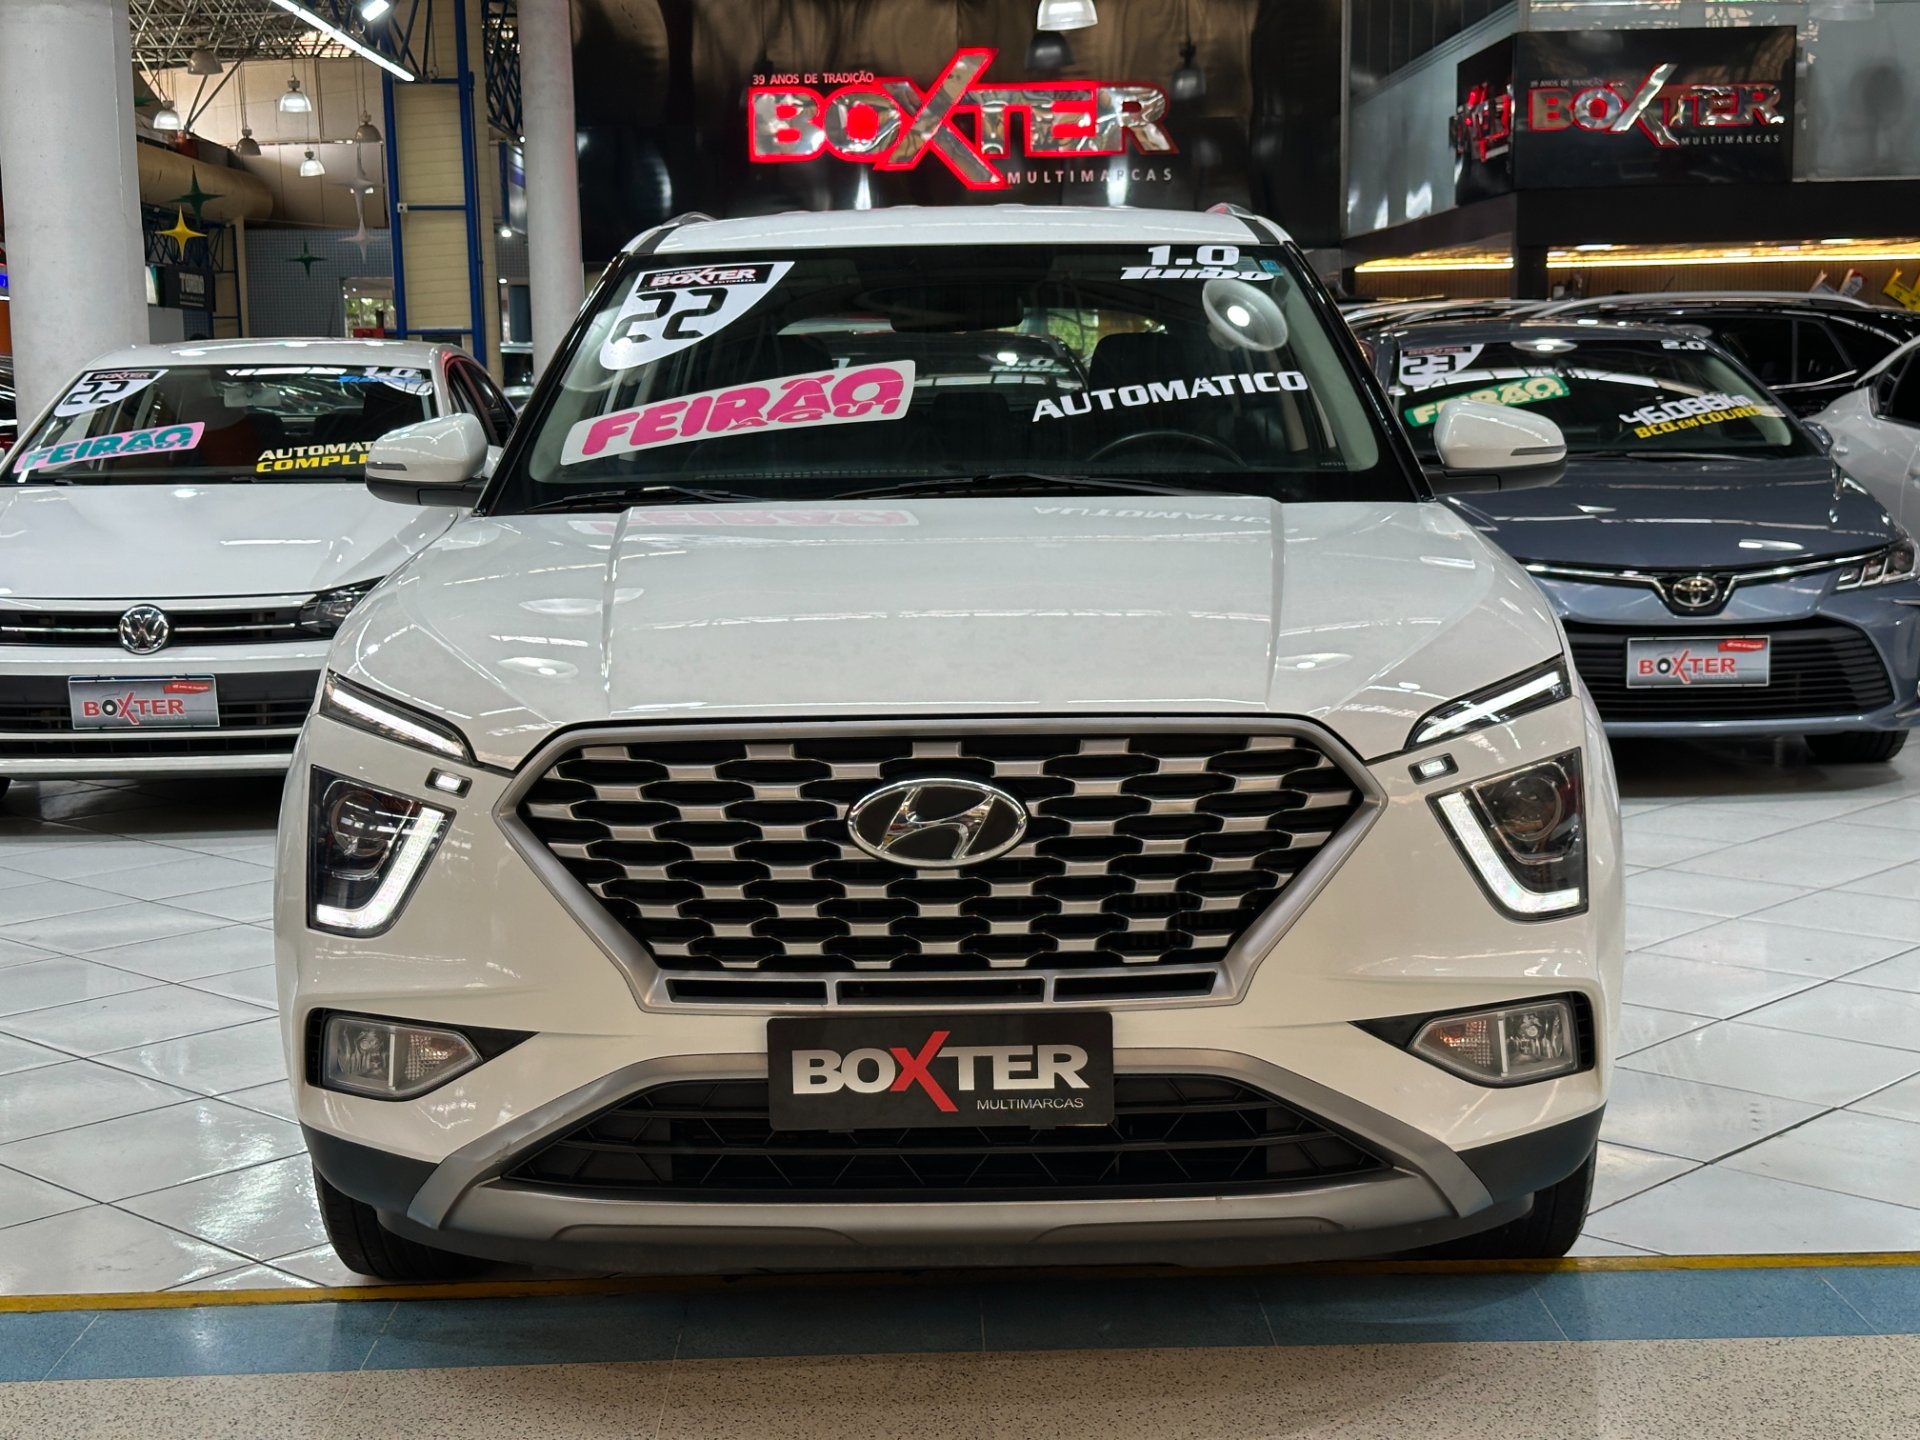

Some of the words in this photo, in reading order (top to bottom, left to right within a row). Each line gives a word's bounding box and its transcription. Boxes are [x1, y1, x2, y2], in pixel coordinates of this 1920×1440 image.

[753, 74, 766, 86] 39
[770, 74, 800, 86] ANOS
[804, 73, 819, 85] DE
[823, 70, 875, 86] TRADIÇÃO
[1528, 63, 1785, 147] BOXTER
[748, 47, 1179, 190] BOXTER
[1681, 134, 1782, 147] MULTIMARCAS
[1007, 167, 1174, 186] MULTIMARCAS
[1148, 245, 1241, 266] 1.0
[650, 267, 757, 287] BOXTER
[1119, 265, 1275, 281] Turbo
[609, 286, 730, 344] 22
[1660, 339, 1706, 351] 2.0
[1402, 354, 1457, 376] 23
[63, 380, 130, 405] 22
[582, 367, 905, 456] FEIRÃO
[23, 426, 193, 470] FEIRÃO
[1638, 649, 1736, 683] BOXTER
[83, 691, 186, 725] BOXTER
[791, 1030, 1090, 1112] BOXTER
[976, 1097, 1085, 1111] MULTIMARCAS
